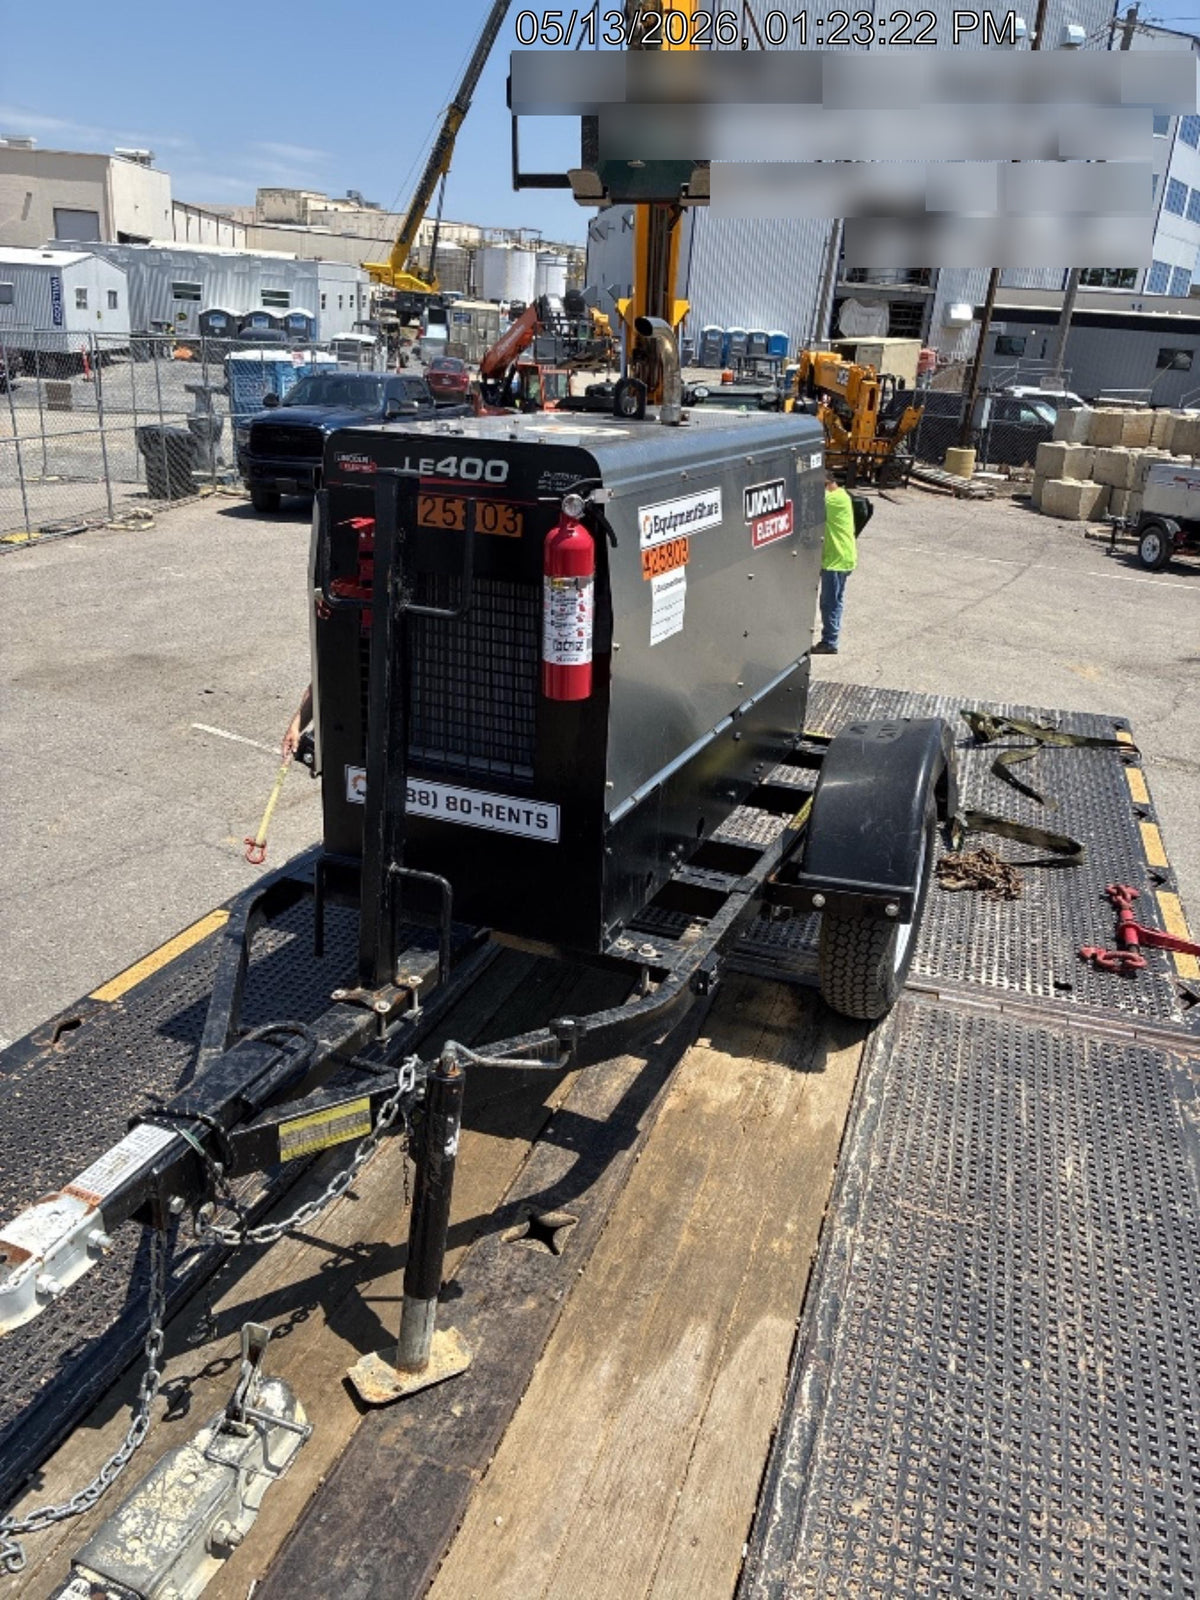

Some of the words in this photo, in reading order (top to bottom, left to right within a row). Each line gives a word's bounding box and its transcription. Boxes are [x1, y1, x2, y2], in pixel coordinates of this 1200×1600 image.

[403, 456, 510, 482] LE400
[746, 485, 785, 518] LINCOLN
[653, 501, 719, 536] EquipmentShare
[757, 513, 790, 542] ELECTRIC
[445, 796, 549, 829] 80-RENTS
